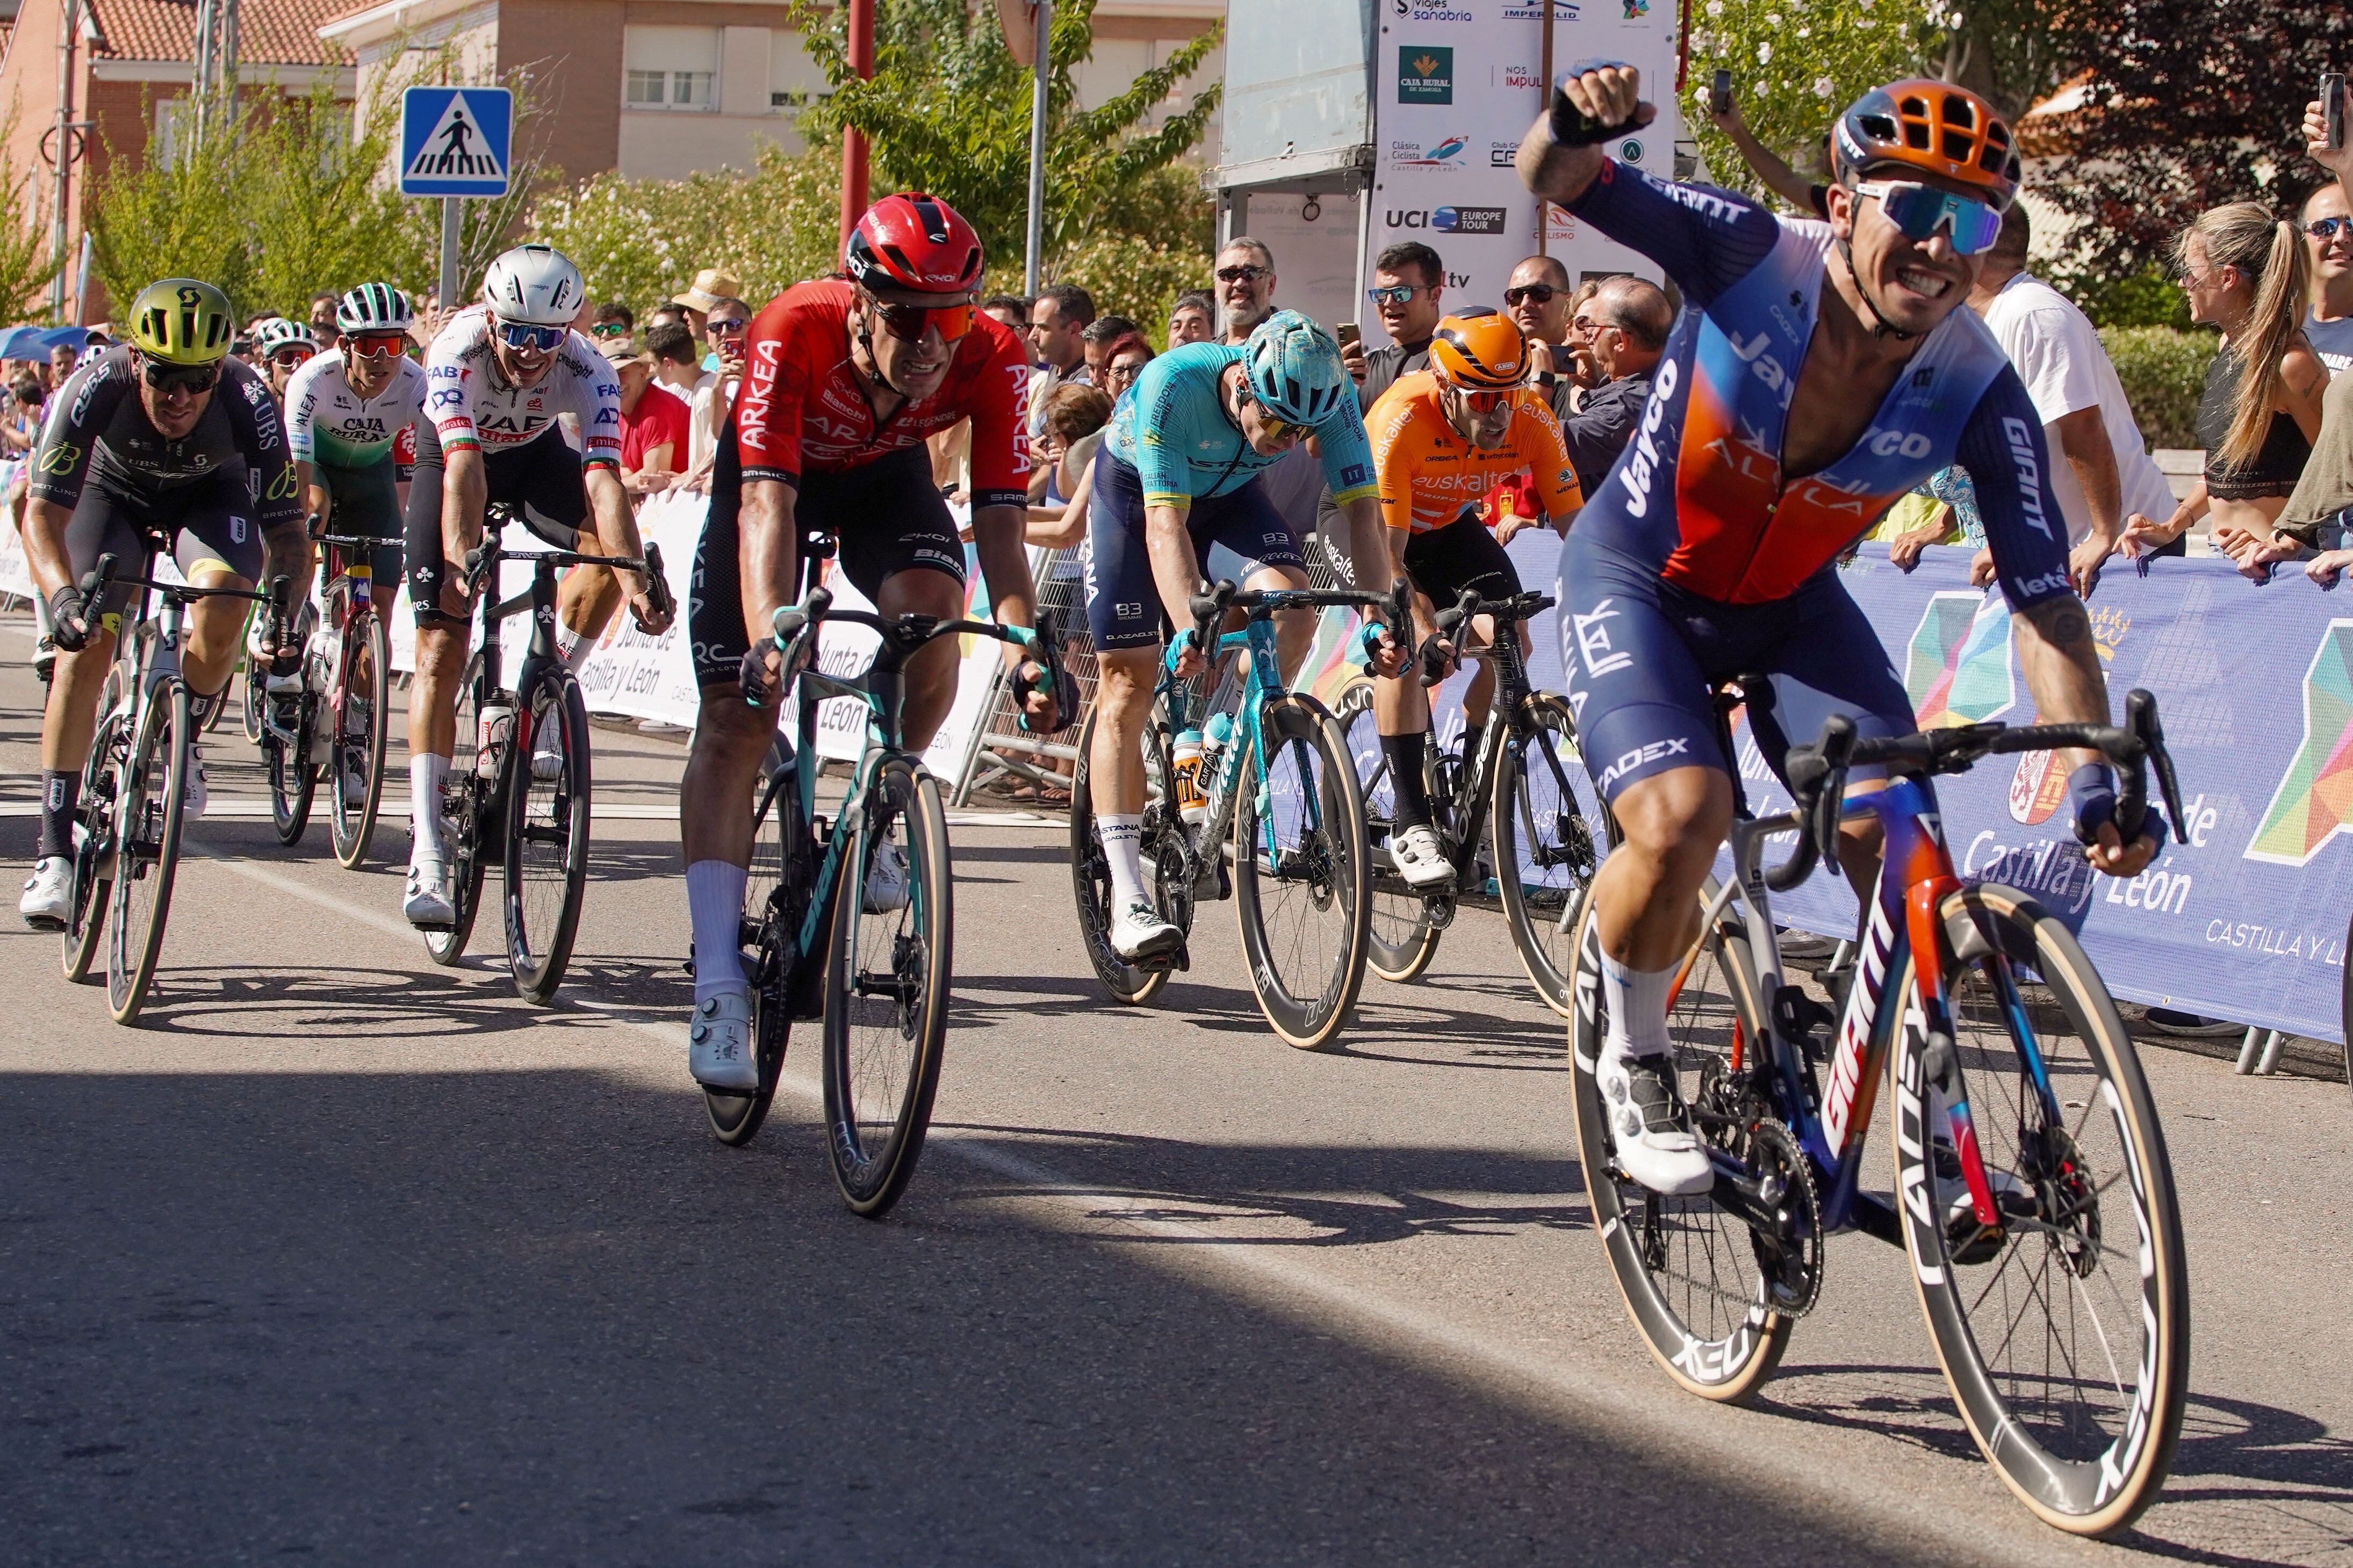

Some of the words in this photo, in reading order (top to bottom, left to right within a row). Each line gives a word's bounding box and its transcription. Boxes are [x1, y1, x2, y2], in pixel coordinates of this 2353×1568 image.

[1414, 10, 1472, 21] sanabria
[1505, 10, 1577, 19] IMPERLID
[1400, 78, 1421, 86] CAJA
[1422, 78, 1451, 87] RURAL
[1506, 66, 1527, 74] NOS
[1392, 141, 1420, 150] Clásica
[1392, 150, 1420, 160] Ciclista
[1386, 210, 1429, 228] UCI
[1461, 211, 1502, 221] EUROPE
[1461, 220, 1489, 230] TOUR
[1533, 232, 1575, 240] CLISMO
[557, 275, 573, 310] MET
[557, 350, 595, 379] presight
[1497, 362, 1514, 370] ABUS
[70, 360, 111, 428] Q36.5
[739, 339, 782, 451] ARKEA
[822, 388, 867, 422] Bianchi
[1149, 380, 1176, 428] FREEDOM
[253, 400, 279, 451] UBS
[296, 393, 318, 427] ALEA
[343, 417, 386, 432] CAJA
[1158, 402, 1173, 433] BROKER
[1338, 403, 1352, 430] BROKER
[1344, 398, 1365, 443] FREEDOM
[1376, 407, 1413, 478] euskaltel
[1522, 403, 1568, 462] euskaltel
[1618, 357, 1679, 518] Jayco
[128, 459, 159, 467] UBS
[1347, 467, 1361, 481] IT
[1144, 480, 1178, 489] TRATTORIA
[1411, 468, 1518, 493] euskalte
[2003, 416, 2054, 542] GIANT
[1262, 532, 1290, 544] B3
[1116, 602, 1142, 616] B3
[577, 659, 616, 692] astilla
[609, 671, 625, 701] y
[625, 659, 660, 695] León
[820, 695, 864, 734] León
[1457, 709, 1498, 846] ORBEA
[2181, 793, 2217, 849] de
[1963, 829, 2069, 895] Castilla
[2069, 868, 2095, 915] y
[2105, 857, 2192, 914] León
[2205, 918, 2303, 957] CASTILLA
[2307, 937, 2322, 959] Y
[1821, 862, 1895, 1160] GIANT
[1896, 978, 1945, 1285] CADEX
